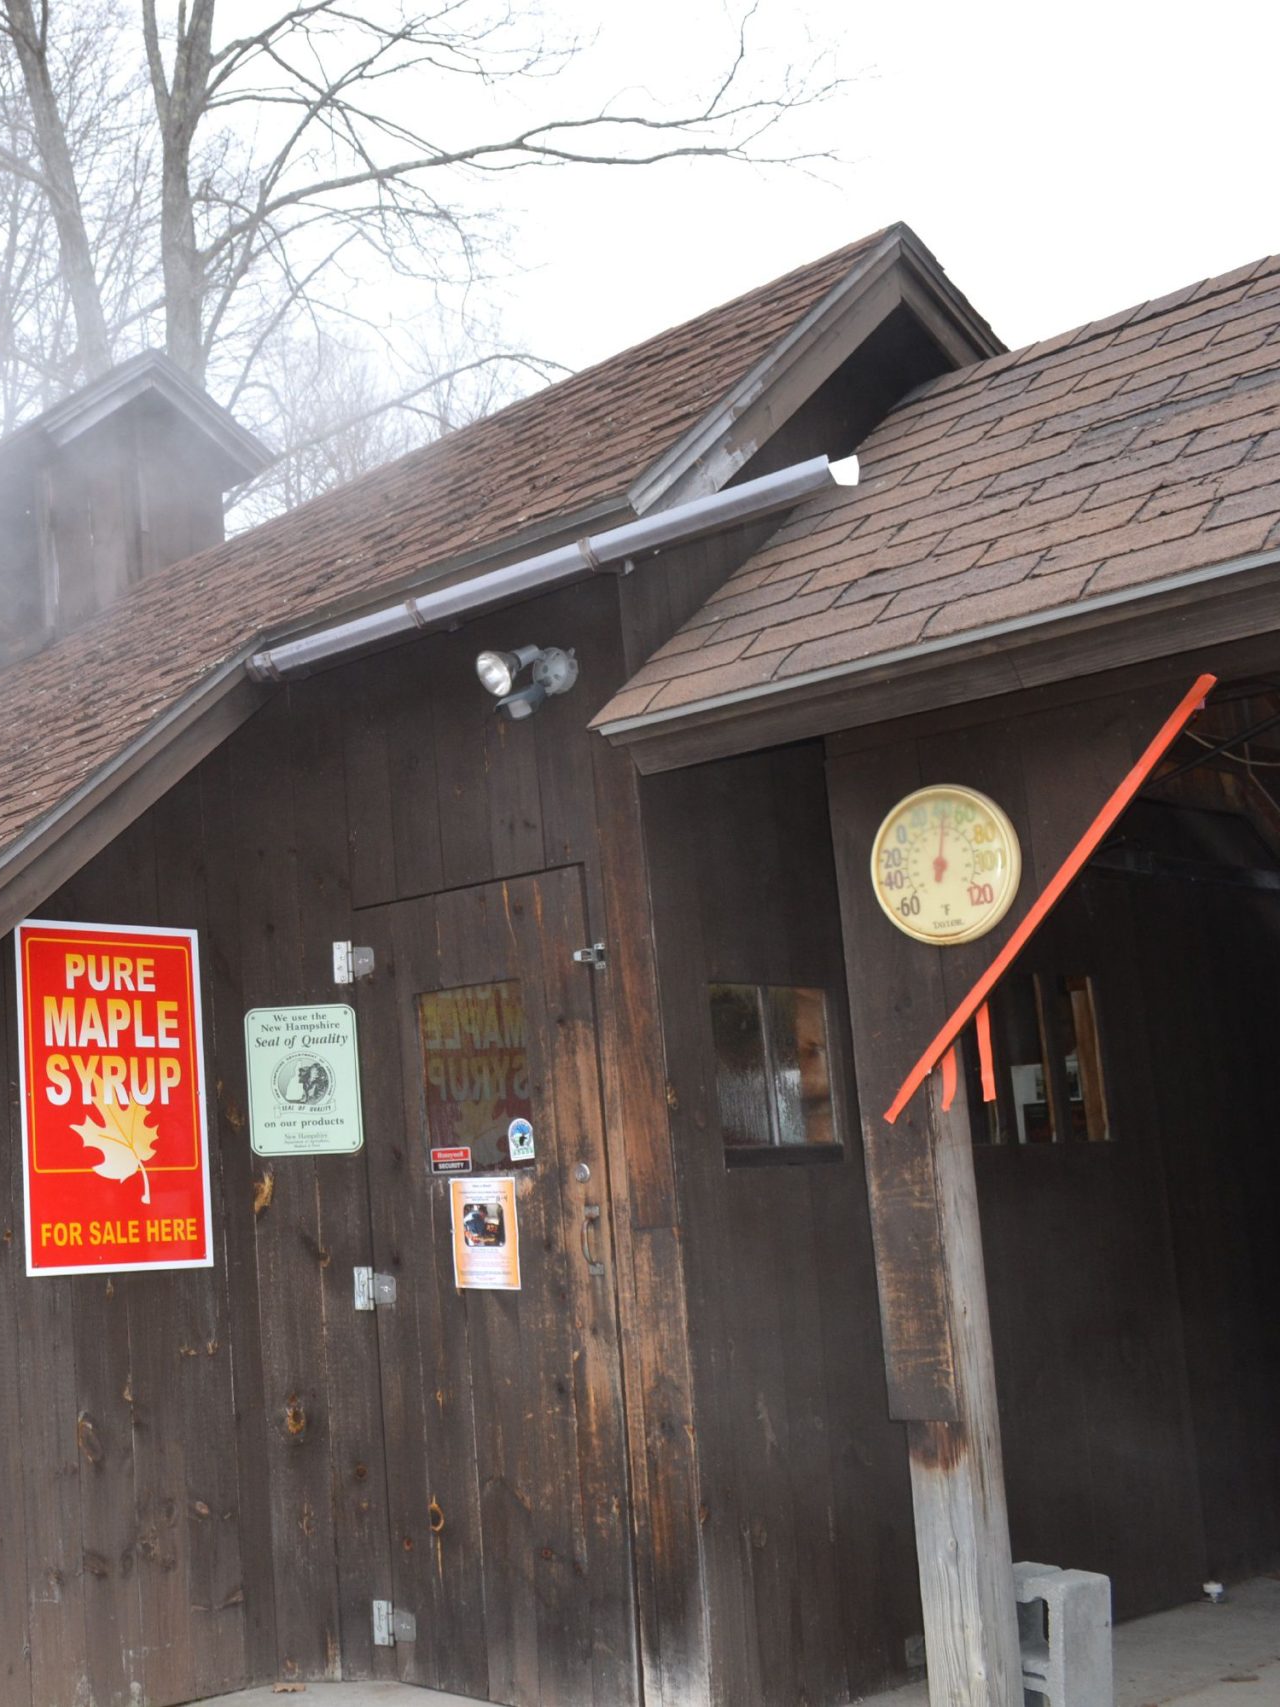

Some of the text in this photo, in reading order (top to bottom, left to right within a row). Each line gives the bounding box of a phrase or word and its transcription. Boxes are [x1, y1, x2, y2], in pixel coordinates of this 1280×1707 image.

[955, 803, 976, 824] 60
[896, 824, 907, 844] 0
[974, 820, 997, 845] 80
[967, 883, 994, 906] 120
[896, 895, 921, 917] -60
[65, 953, 156, 992] PURE
[43, 996, 181, 1048] MAPLE
[261, 1021, 340, 1032] New Hampshire
[273, 1014, 287, 1022] We
[312, 1012, 326, 1020] the
[255, 1033, 348, 1049] Seal of Quality
[45, 1054, 182, 1106] SYRUP
[301, 1117, 344, 1128] products
[41, 1218, 198, 1247] FOR SALE HERE
